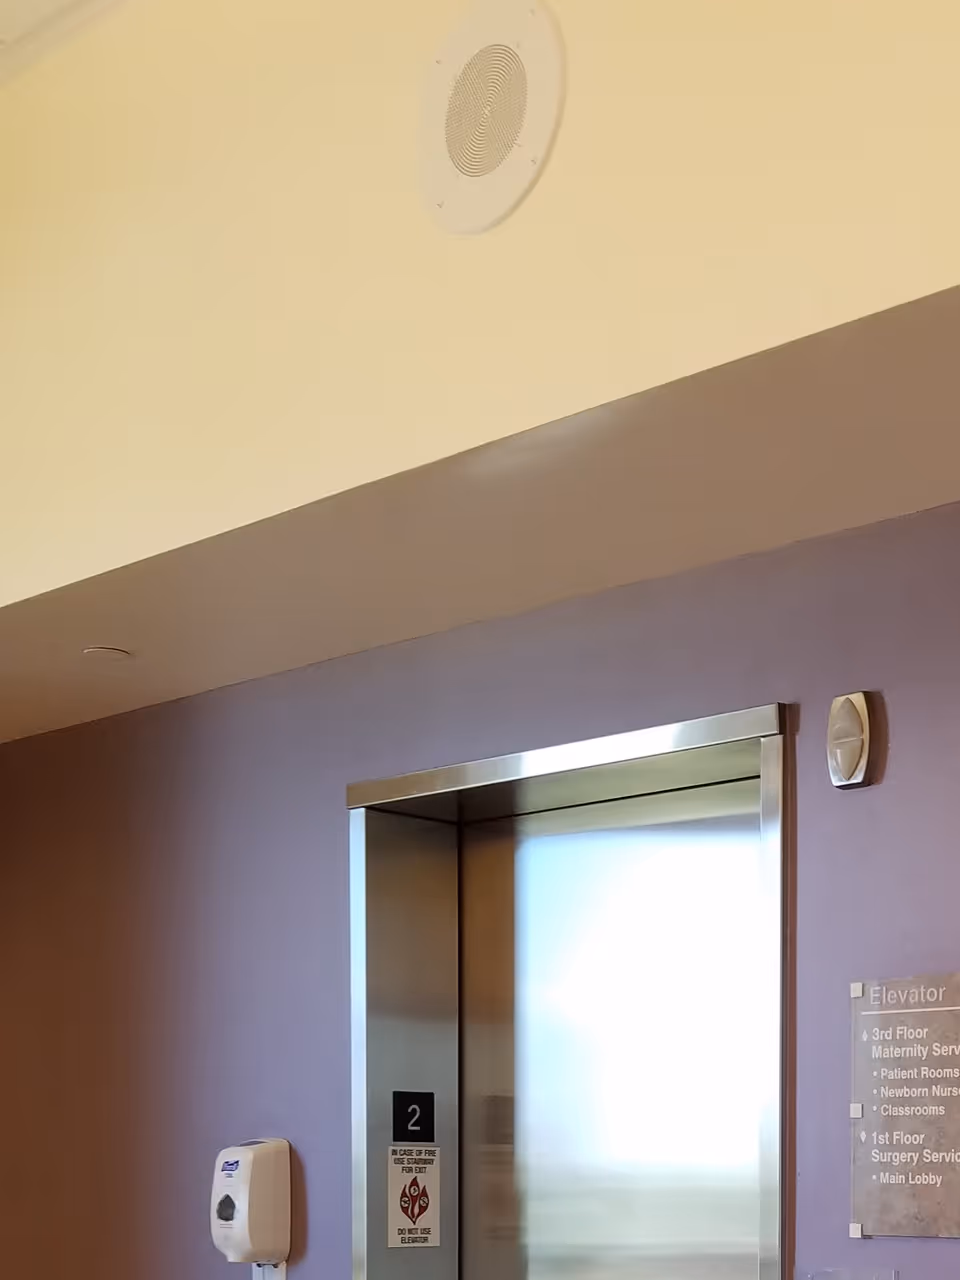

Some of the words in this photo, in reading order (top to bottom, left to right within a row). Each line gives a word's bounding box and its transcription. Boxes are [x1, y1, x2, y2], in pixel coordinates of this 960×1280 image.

[870, 986, 946, 1005] Elevator
[872, 1027, 893, 1041] 3rd
[896, 1026, 929, 1040] Floor
[872, 1044, 929, 1060] Maternity
[880, 1068, 918, 1080] Patient
[921, 1066, 960, 1078] Rooms
[880, 1086, 929, 1098] Newborn
[407, 1104, 421, 1131] 2
[880, 1104, 946, 1116] Classrooms
[871, 1131, 890, 1145] 1st
[893, 1131, 926, 1145] Floor
[871, 1149, 919, 1166] Surgery
[880, 1172, 906, 1185] Main
[908, 1172, 943, 1187] Lobby
